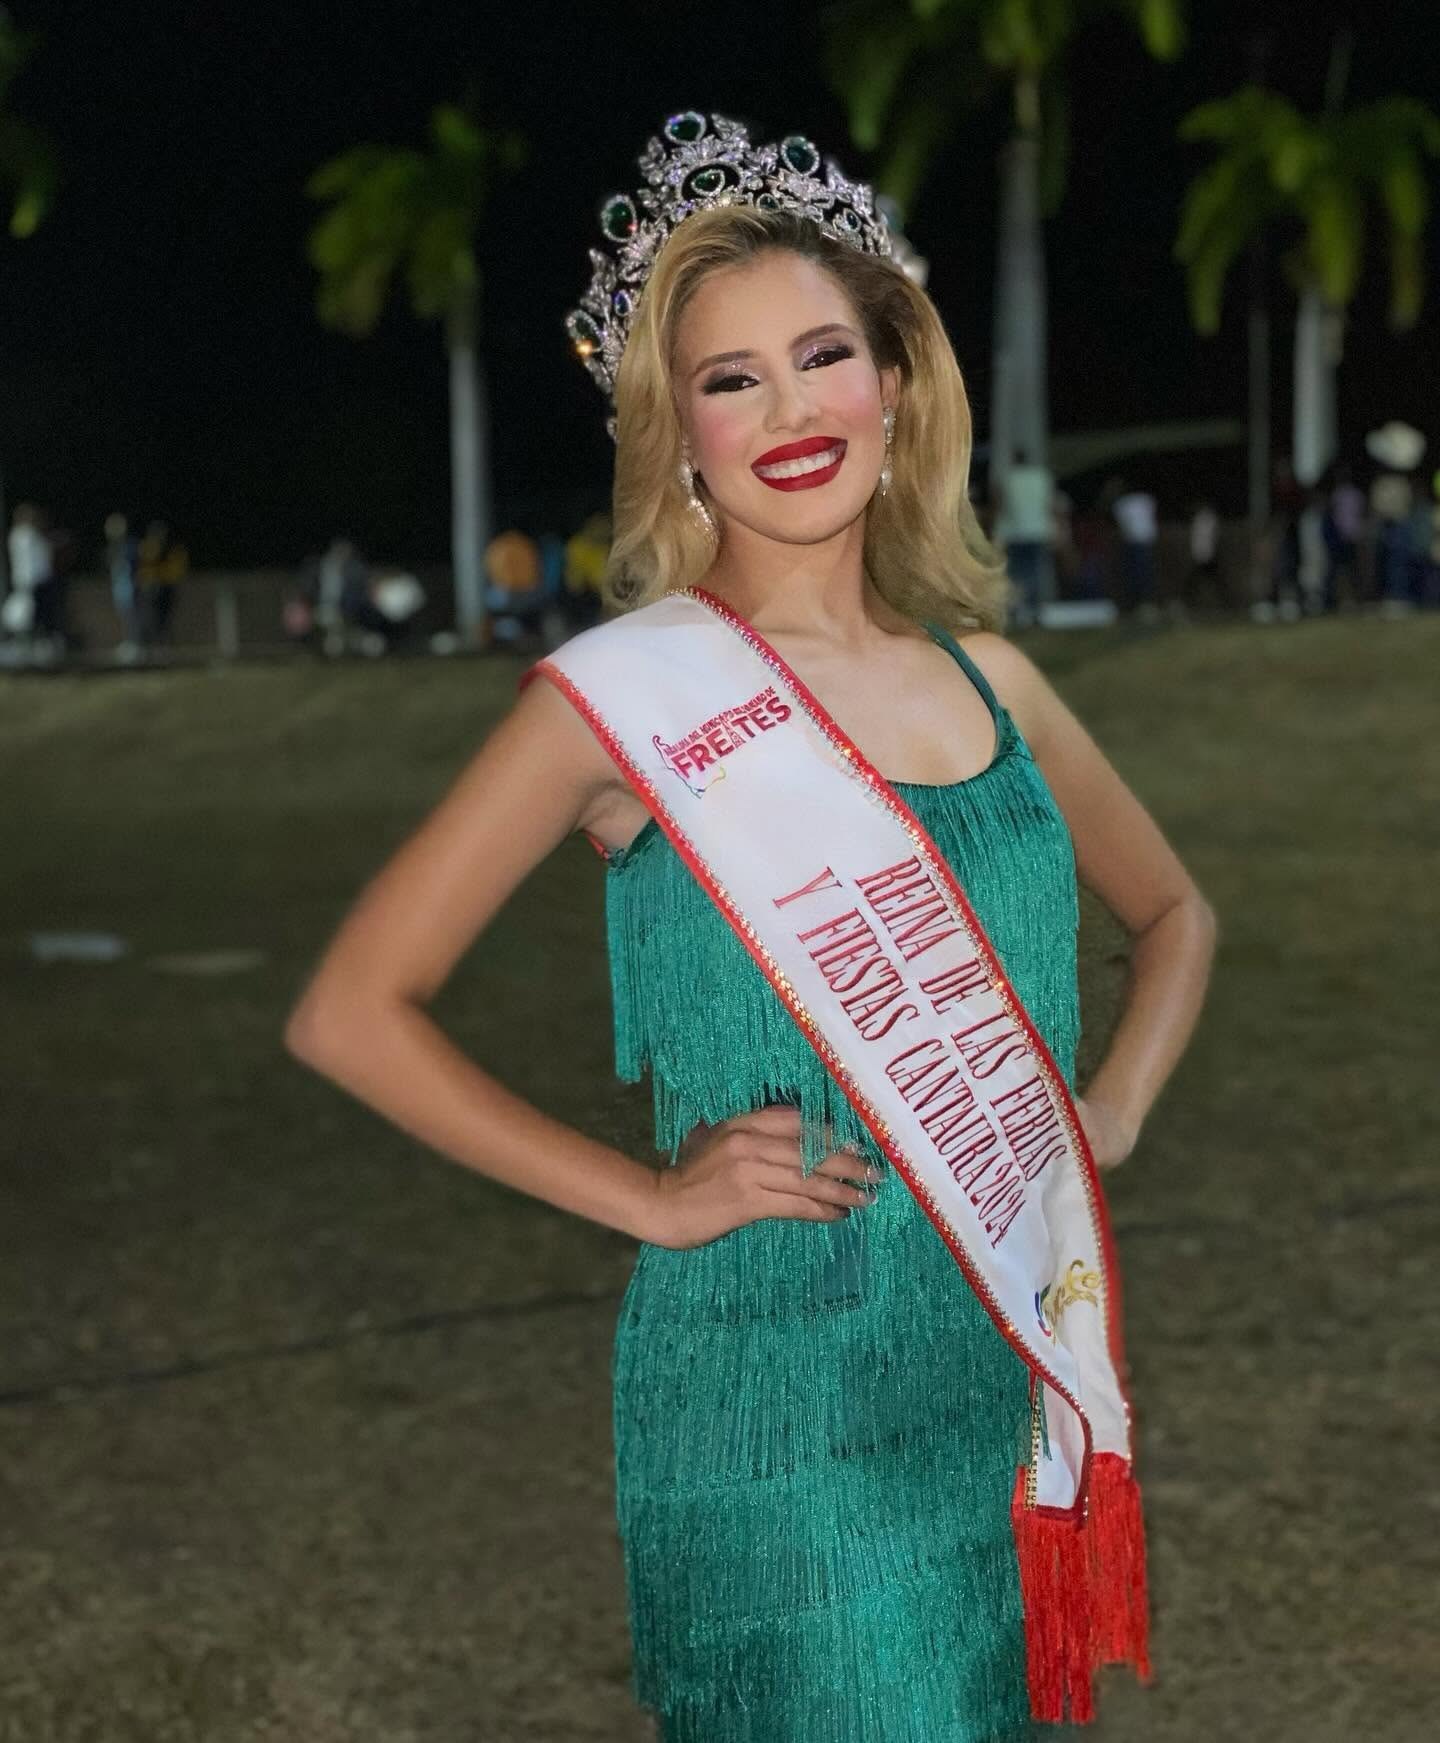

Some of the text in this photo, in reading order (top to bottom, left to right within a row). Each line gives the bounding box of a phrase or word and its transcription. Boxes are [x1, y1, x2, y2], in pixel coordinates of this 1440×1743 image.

[772, 866, 842, 911] Y
[797, 907, 920, 1042] FIESTAS
[855, 855, 1068, 1183] REINA DE LAS FERIAS
